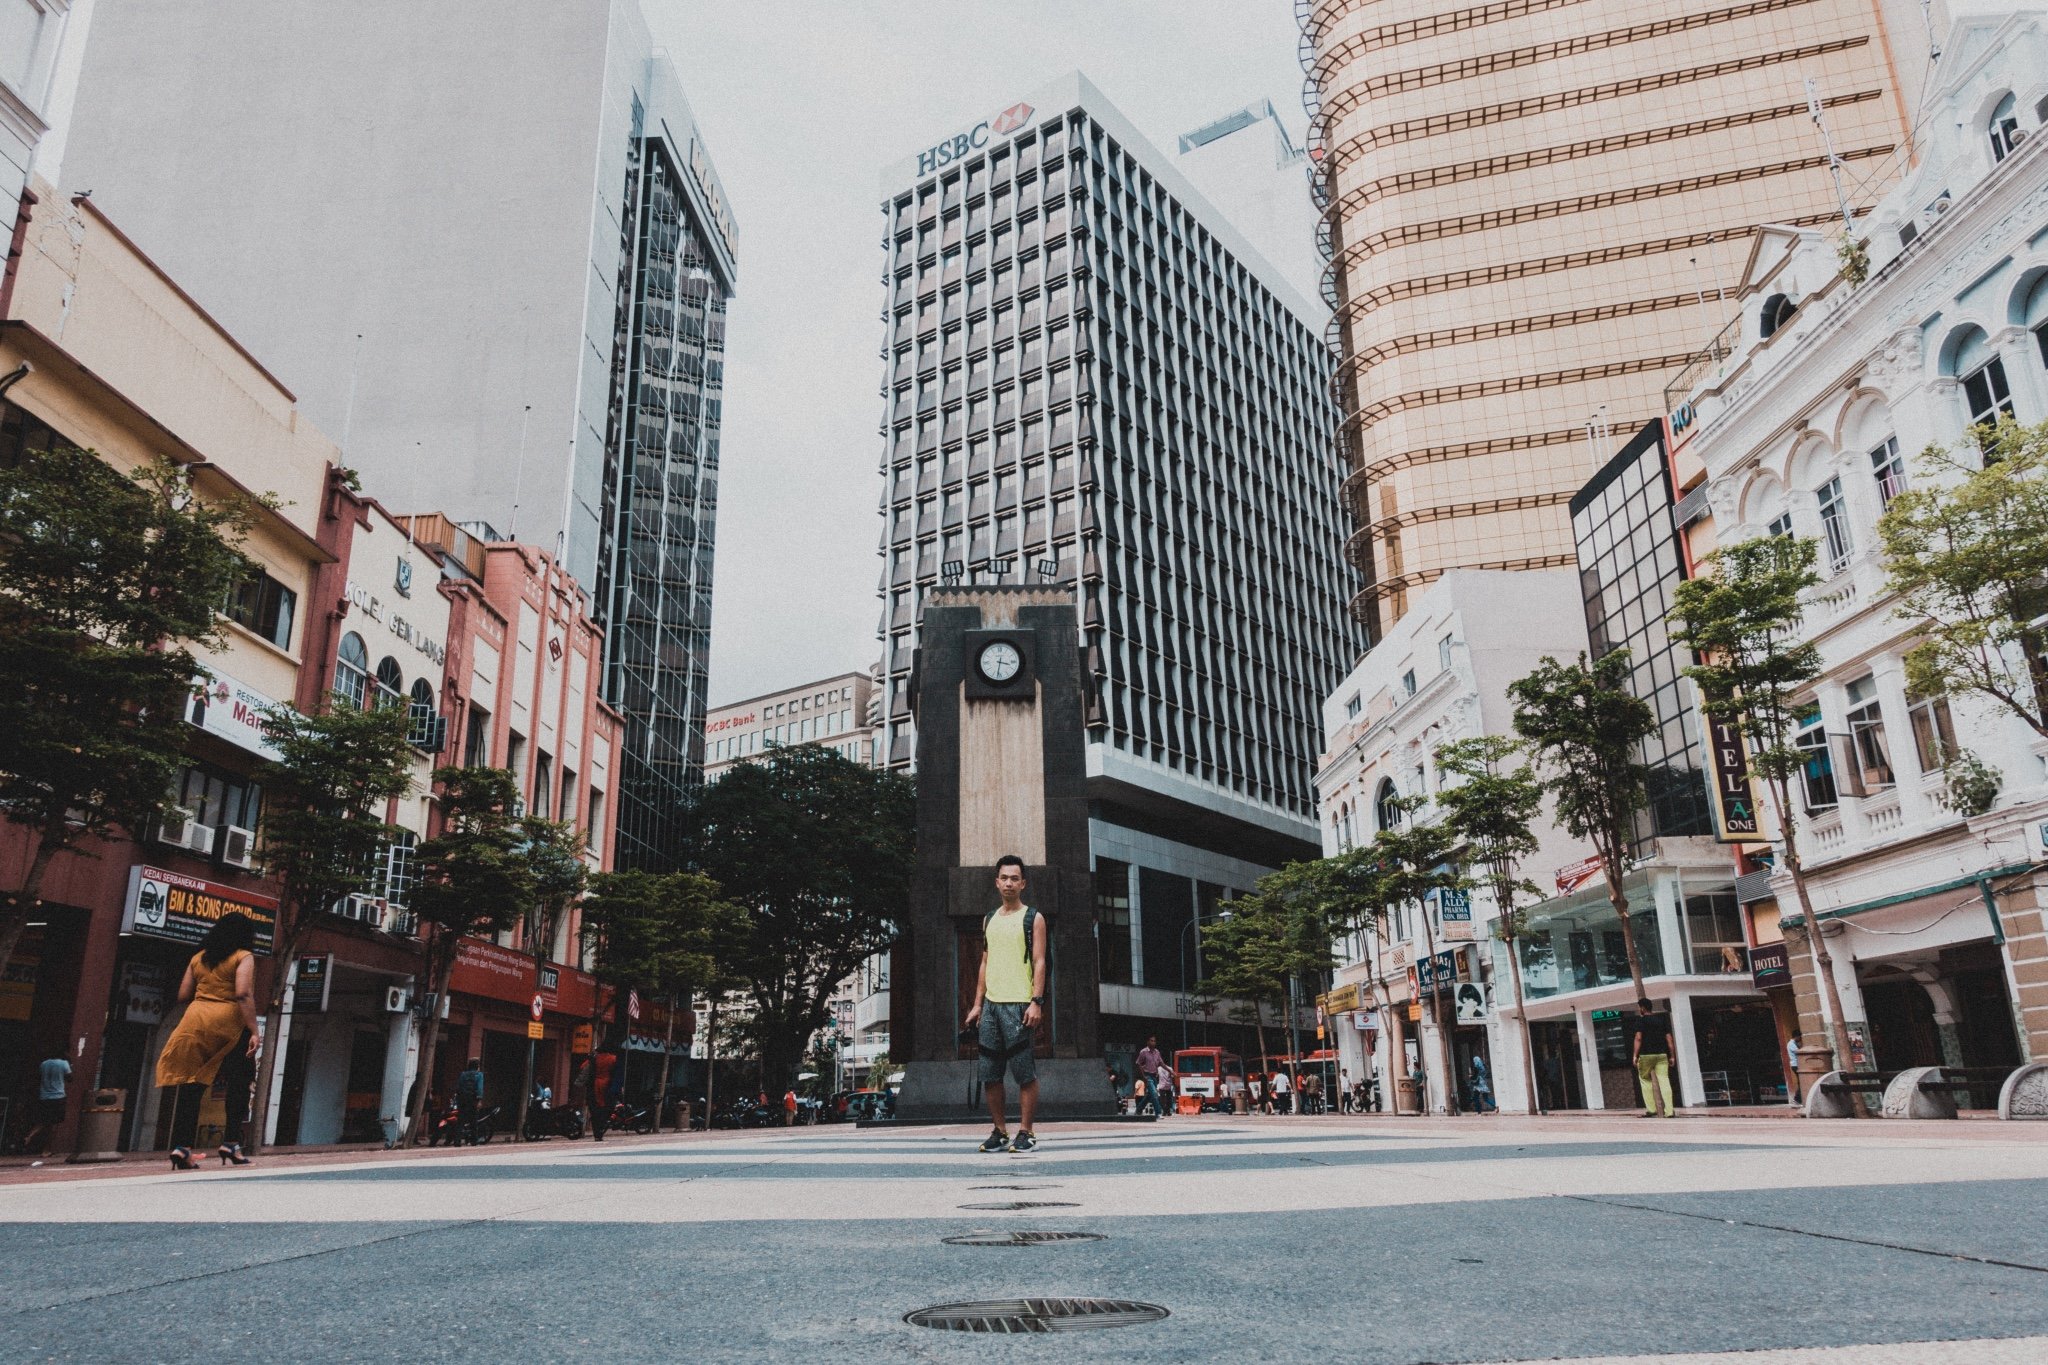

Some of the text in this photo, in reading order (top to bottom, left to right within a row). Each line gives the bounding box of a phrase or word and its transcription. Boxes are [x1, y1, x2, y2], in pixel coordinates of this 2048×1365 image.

[917, 120, 989, 178] HSBC
[345, 581, 385, 623] KOLEJ
[236, 689, 273, 711] RESTORAN
[706, 712, 755, 733] OCBC Bank
[1717, 716, 1743, 792] TEL
[1731, 802, 1749, 819] A
[1727, 820, 1756, 831] ONE
[144, 868, 206, 890] KEDAI SERBANEKA AM
[139, 890, 165, 913] BM
[169, 889, 186, 912] BM
[186, 893, 194, 914] &
[195, 895, 222, 920] SONS
[1444, 898, 1466, 907] ALLY
[1754, 956, 1784, 972] HOTEL
